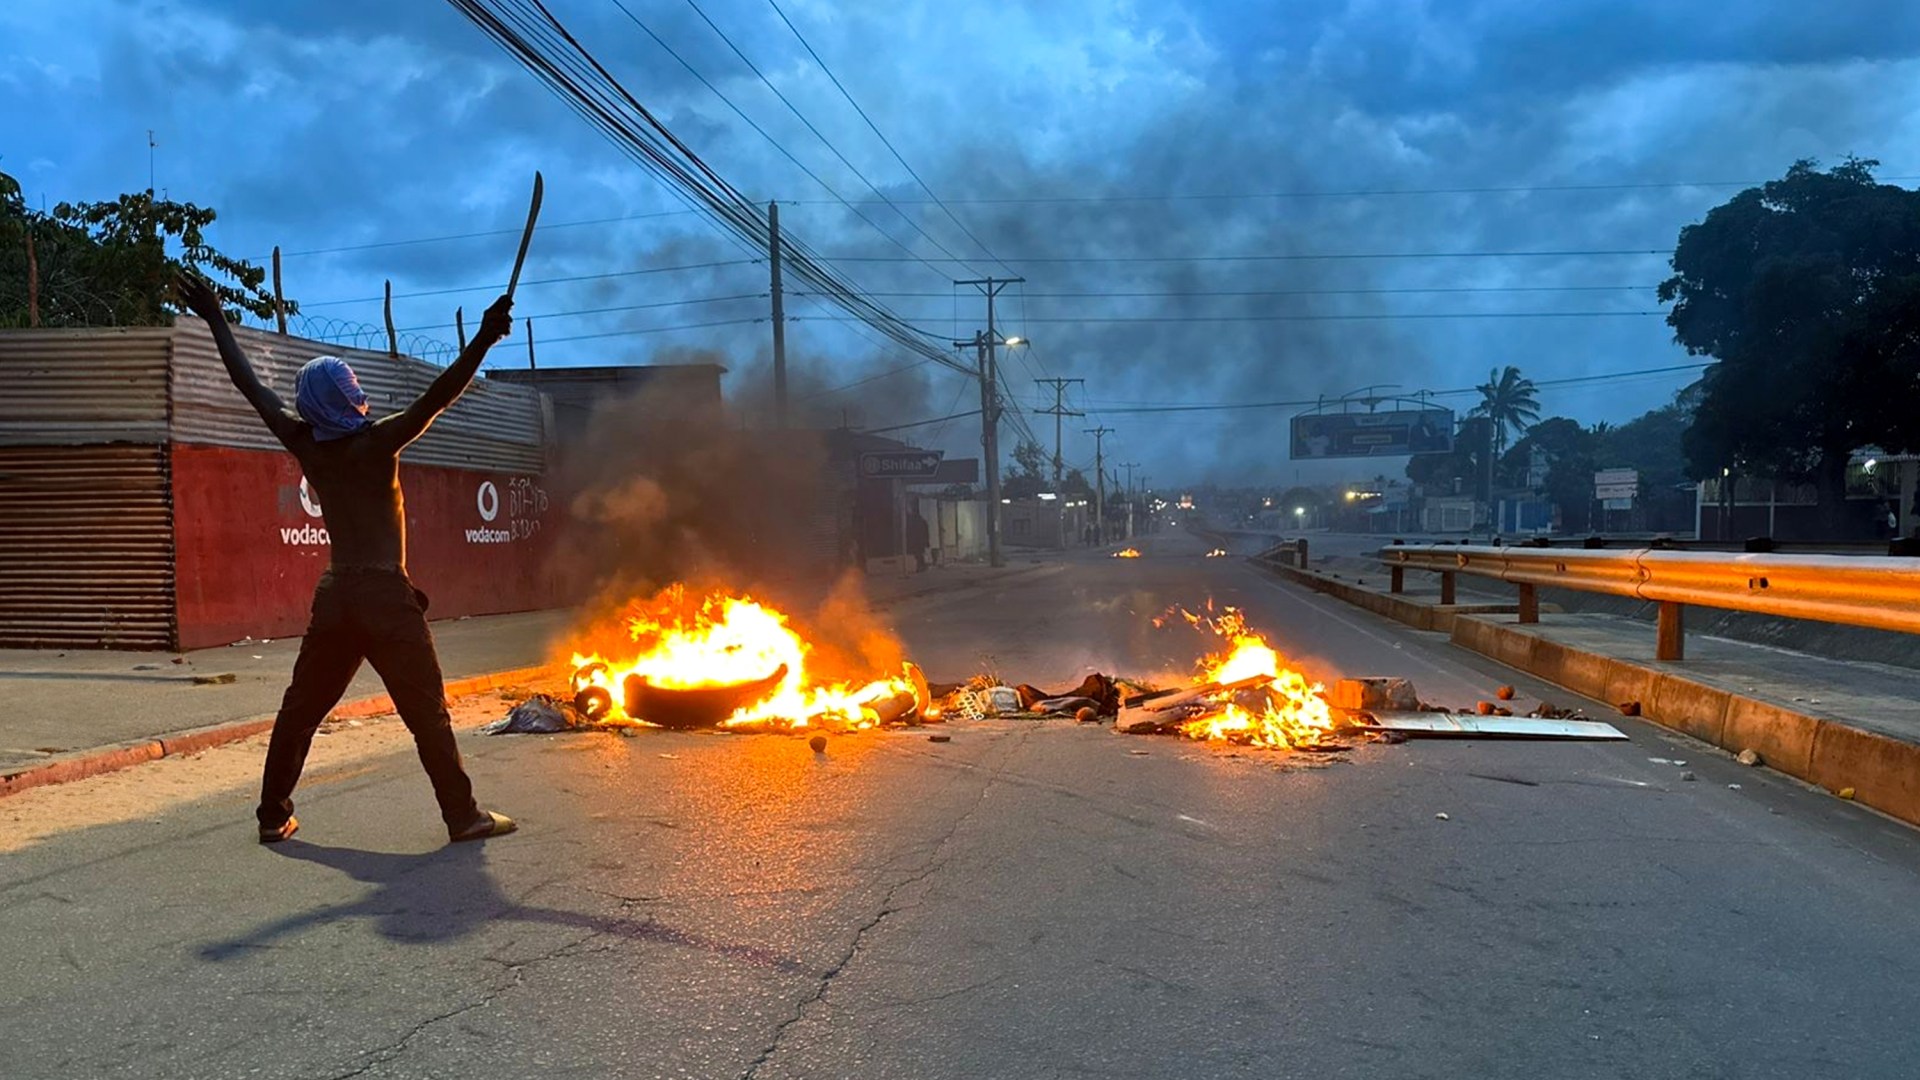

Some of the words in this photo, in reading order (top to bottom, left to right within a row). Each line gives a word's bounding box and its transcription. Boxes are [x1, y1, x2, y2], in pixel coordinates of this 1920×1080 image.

[881, 458, 923, 471] Shifaa
[280, 523, 331, 545] vodac
[465, 525, 510, 543] vodacom
